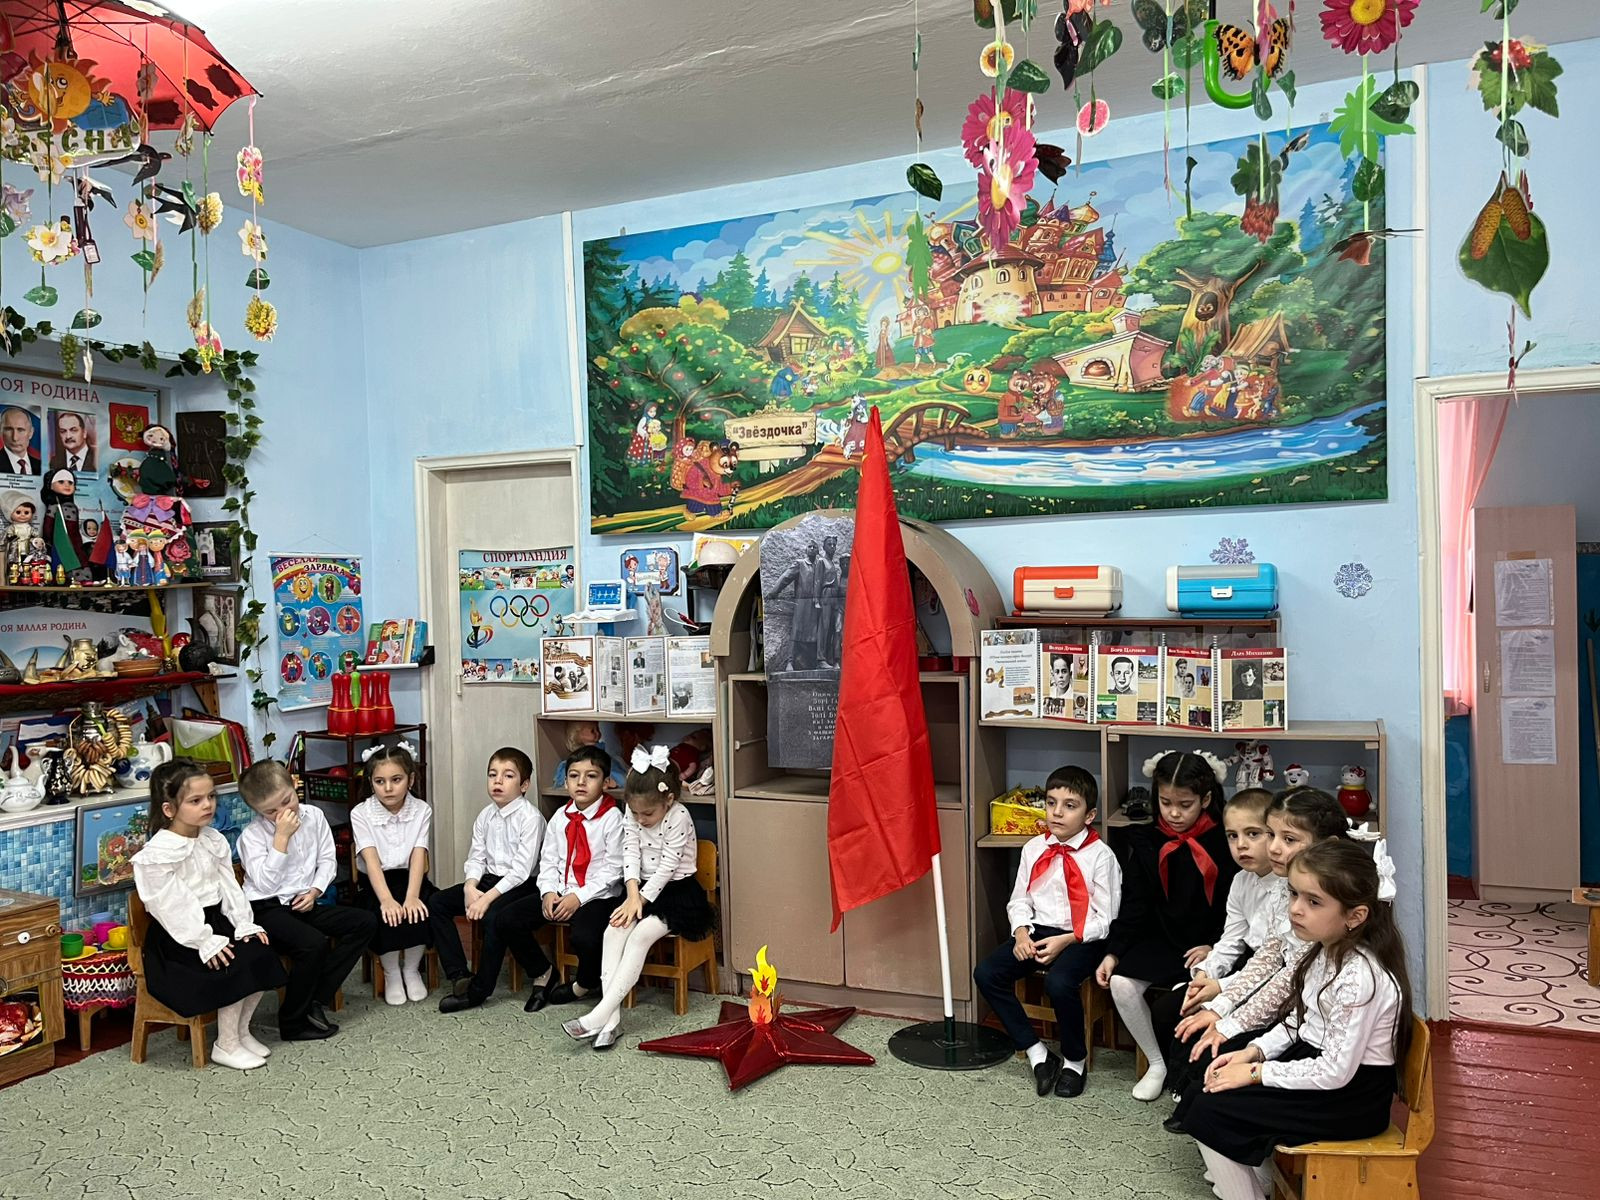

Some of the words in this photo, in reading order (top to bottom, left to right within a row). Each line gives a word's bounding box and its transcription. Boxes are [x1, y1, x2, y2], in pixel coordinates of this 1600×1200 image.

[0, 377, 24, 393] ОЯ
[31, 381, 100, 403] РОДИНА
[483, 549, 567, 563] СПОРТЛАНДИЯ
[303, 563, 346, 575] ЗАРЯДКА
[0, 624, 14, 632] ОЯ
[16, 623, 48, 632] МАЛАЯ
[50, 622, 87, 631] РОДИНА
